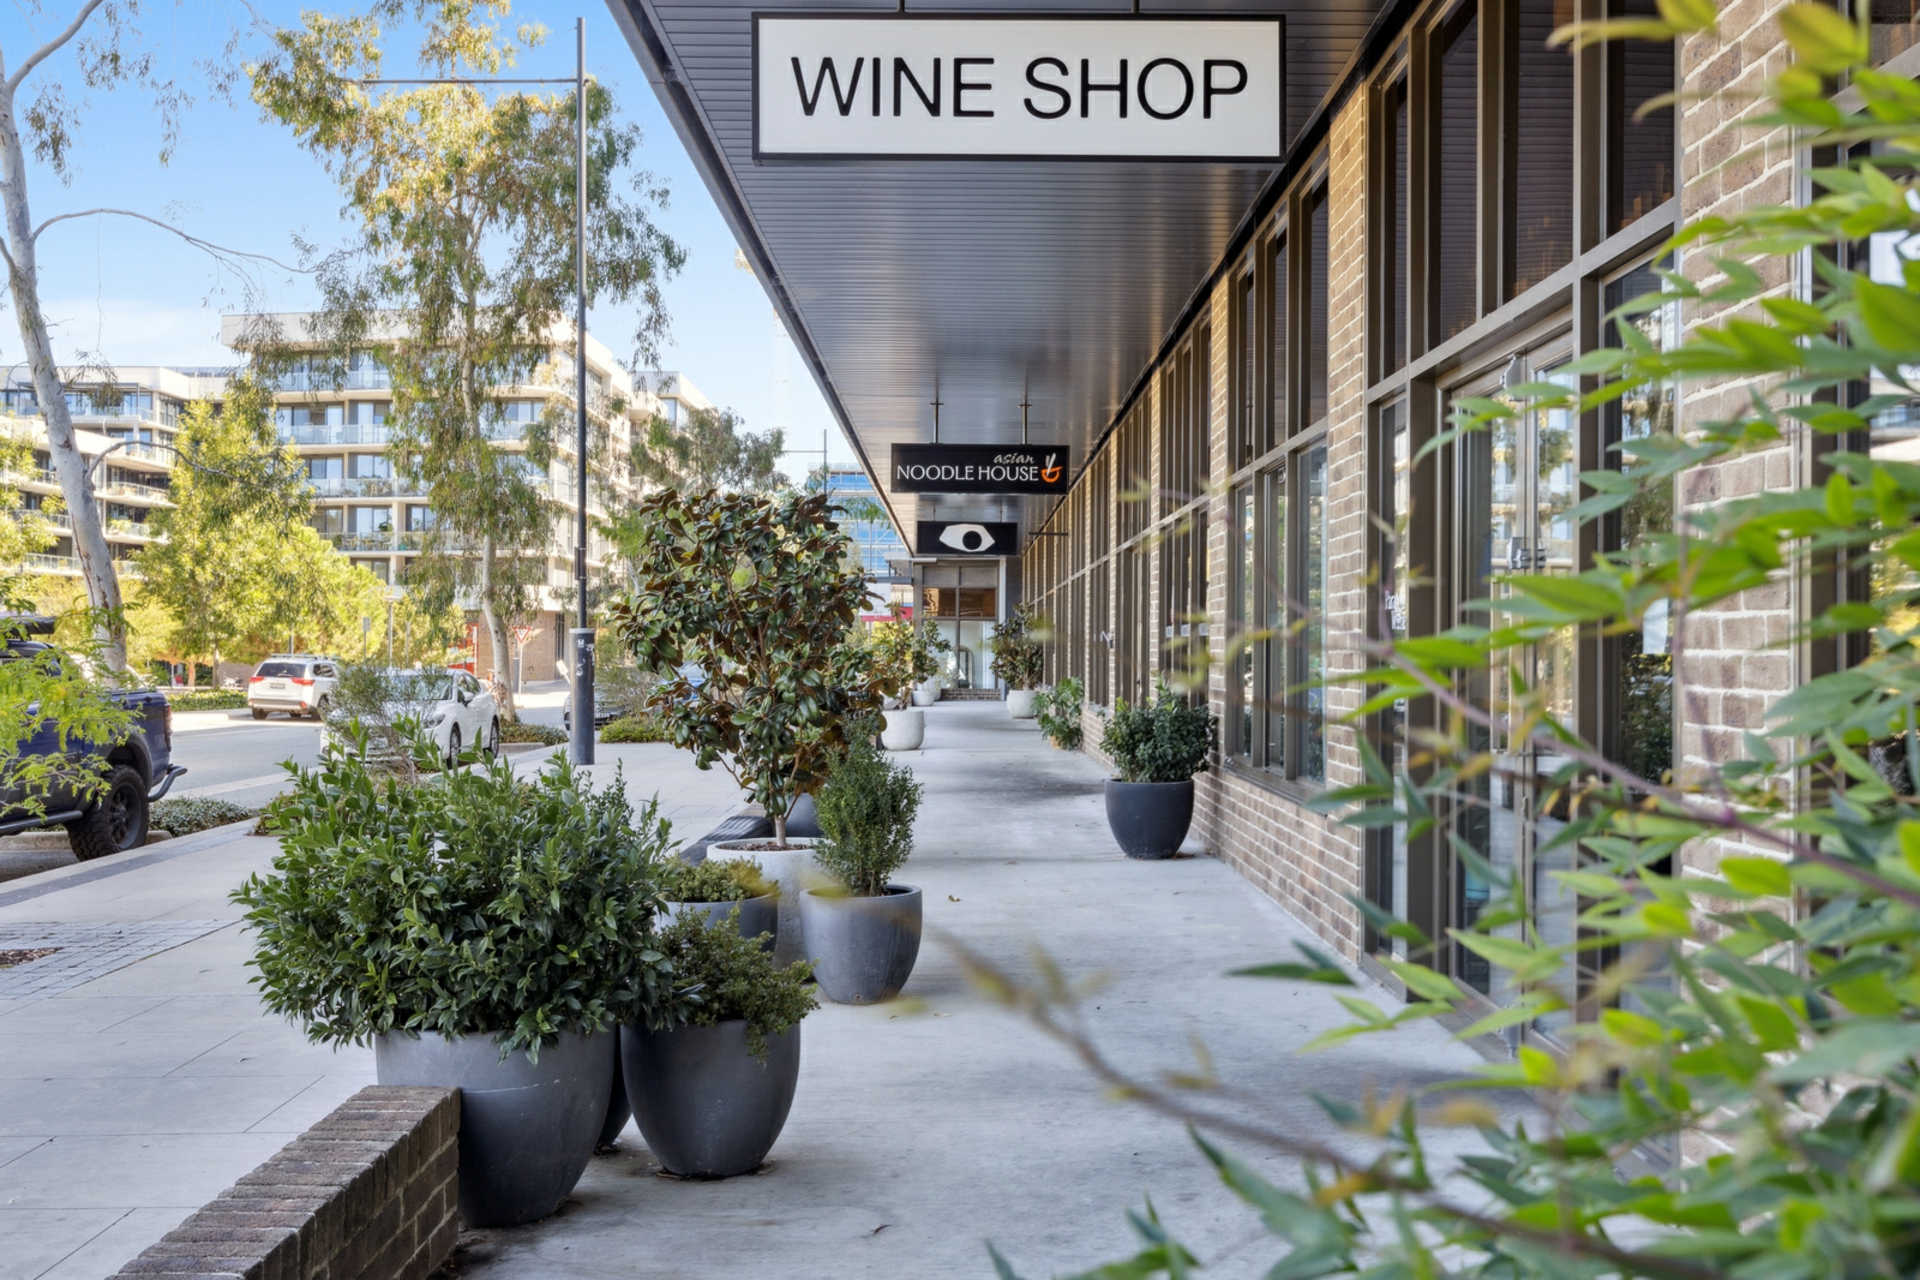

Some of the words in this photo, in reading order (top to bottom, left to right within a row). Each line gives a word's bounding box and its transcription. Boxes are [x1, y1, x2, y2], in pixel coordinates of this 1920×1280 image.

[790, 56, 995, 118] WINE
[1023, 56, 1248, 120] SHOP
[993, 452, 1035, 464] asian
[897, 464, 975, 481] NOODLE
[978, 465, 1039, 482] HOUSE
